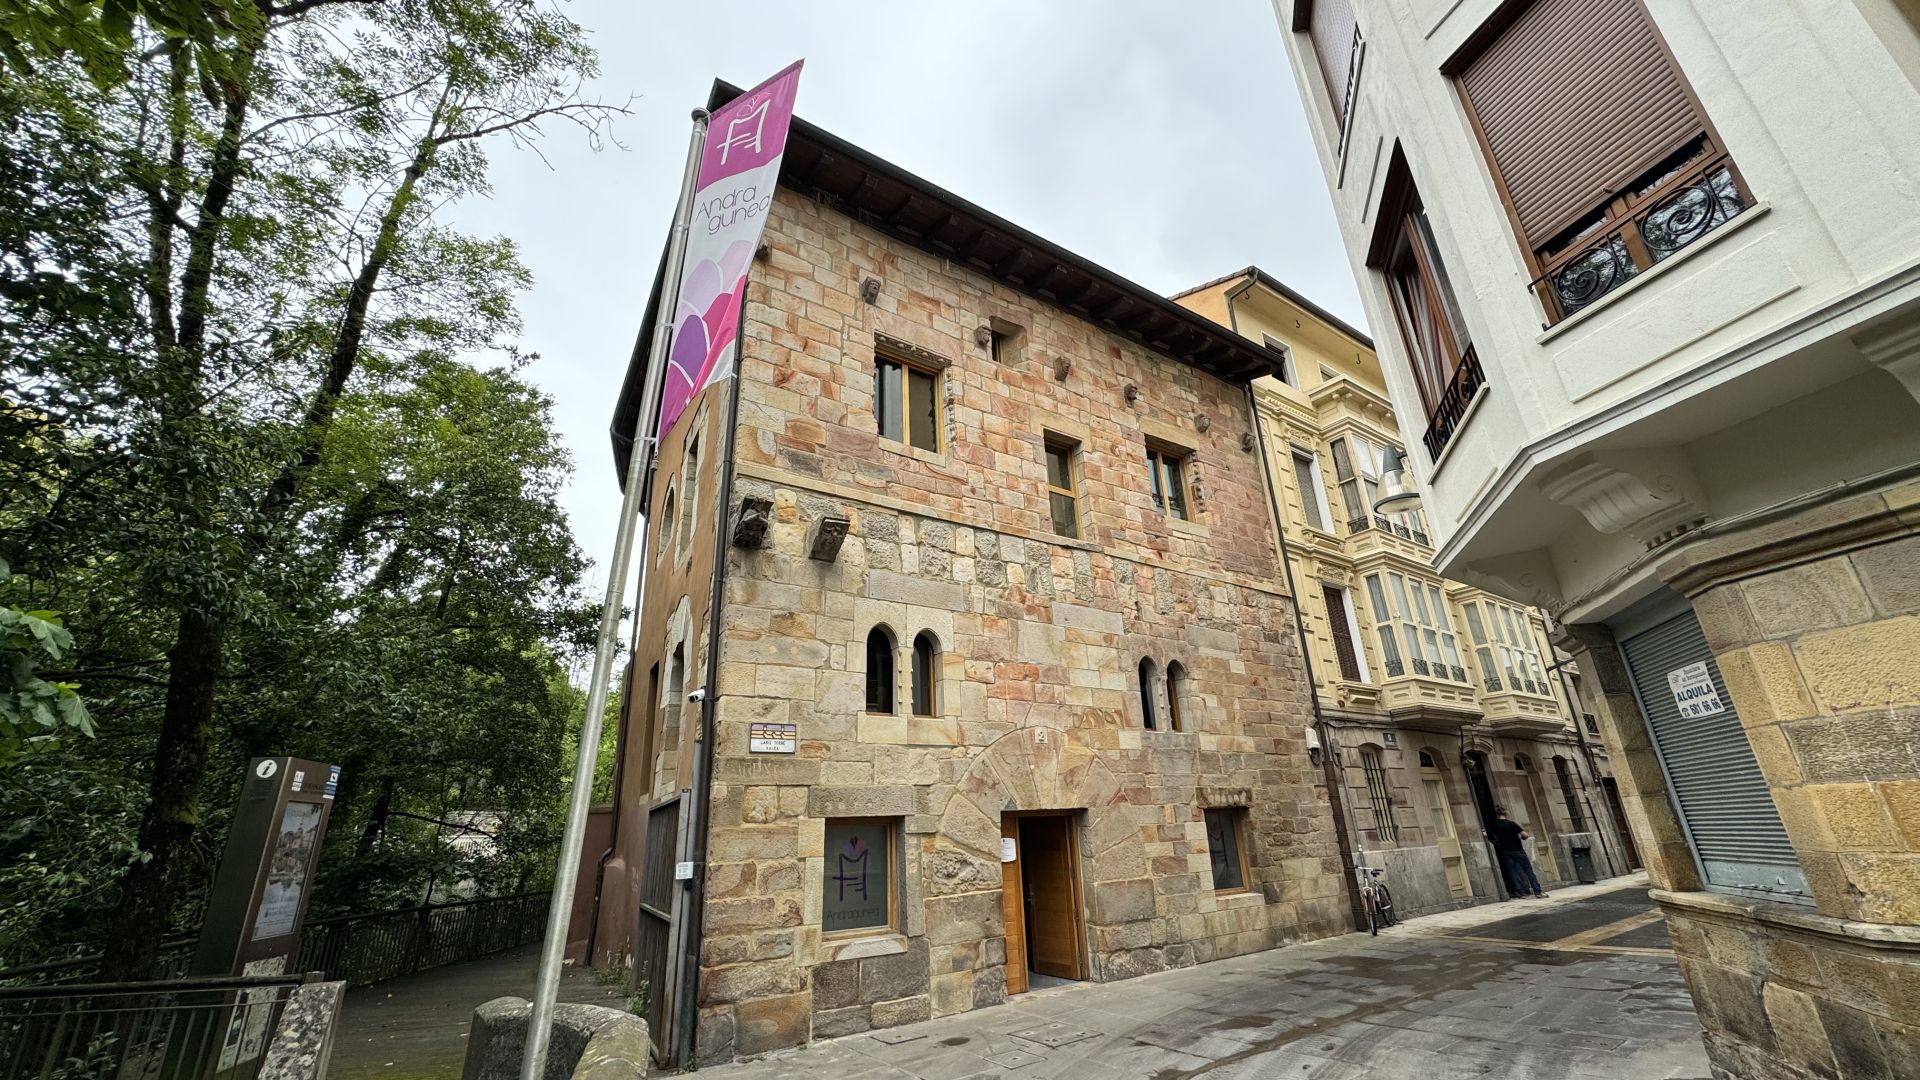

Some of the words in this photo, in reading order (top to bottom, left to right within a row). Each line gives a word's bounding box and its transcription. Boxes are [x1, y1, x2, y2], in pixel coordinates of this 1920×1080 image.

[696, 185, 756, 222] Andra
[708, 193, 771, 235] gunea
[1677, 683, 1713, 702] ALQUILA
